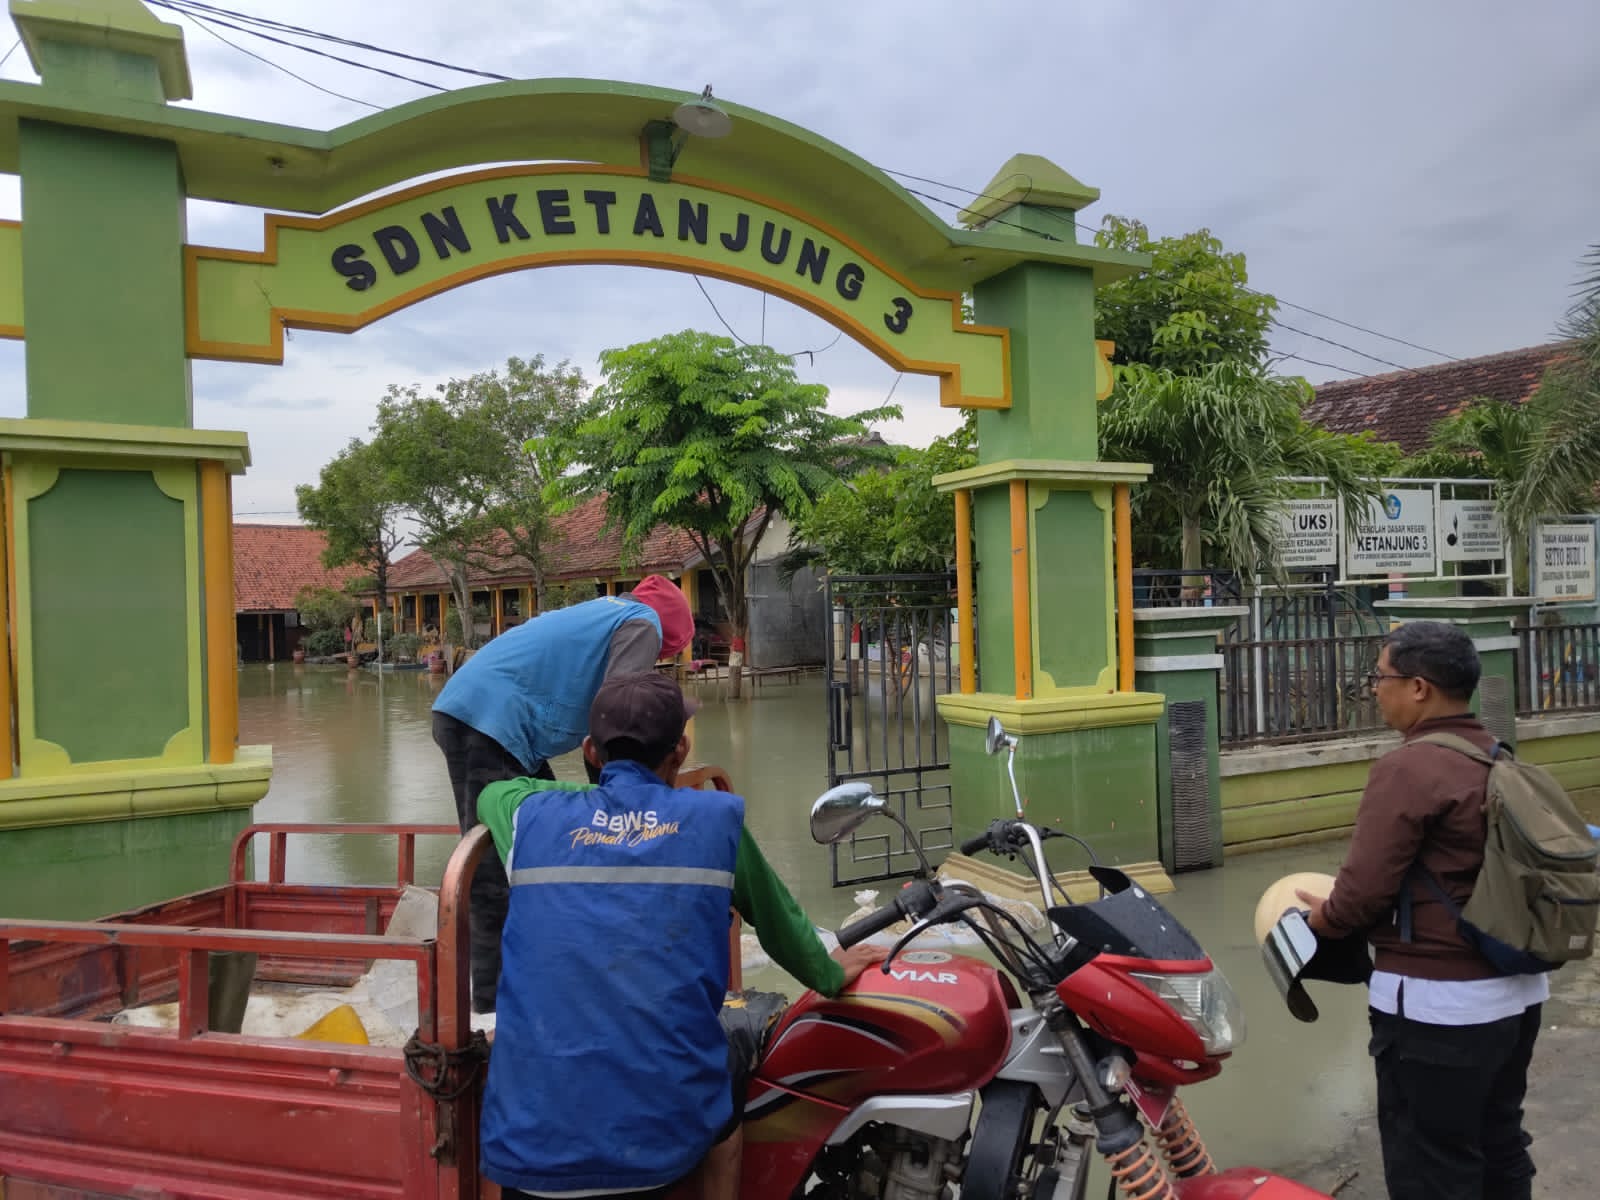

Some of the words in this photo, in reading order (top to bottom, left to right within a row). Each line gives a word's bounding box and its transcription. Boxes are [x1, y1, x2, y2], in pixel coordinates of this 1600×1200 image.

[331, 206, 471, 291] SDN
[486, 189, 866, 301] KETANJUNG
[883, 296, 913, 334] 3
[1357, 535, 1420, 551] KETANJUNG
[1422, 535, 1428, 550] 3
[592, 809, 658, 832] BBWS
[889, 970, 958, 984] VIAR
